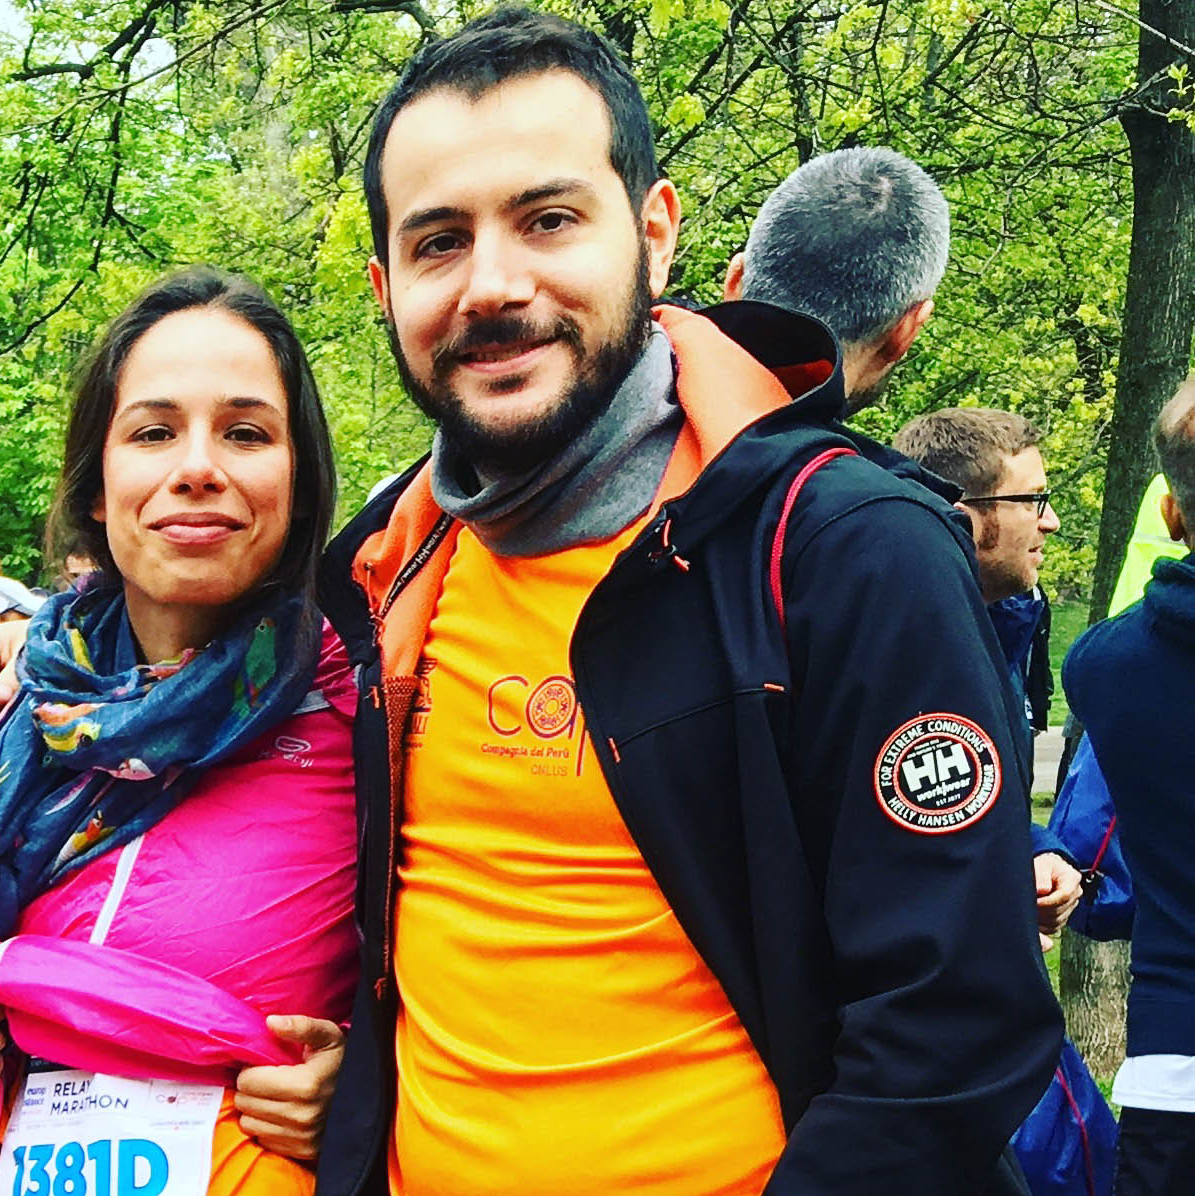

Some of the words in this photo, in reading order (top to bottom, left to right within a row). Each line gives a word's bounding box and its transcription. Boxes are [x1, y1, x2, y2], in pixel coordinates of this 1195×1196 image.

[884, 724, 925, 766] EXTREME
[928, 720, 987, 753] CONDITIONS
[880, 766, 893, 787] FOR
[902, 743, 971, 792] HH
[888, 796, 917, 822] HELLY
[917, 811, 966, 826] HANSEN
[964, 764, 994, 816] WORKWEAR
